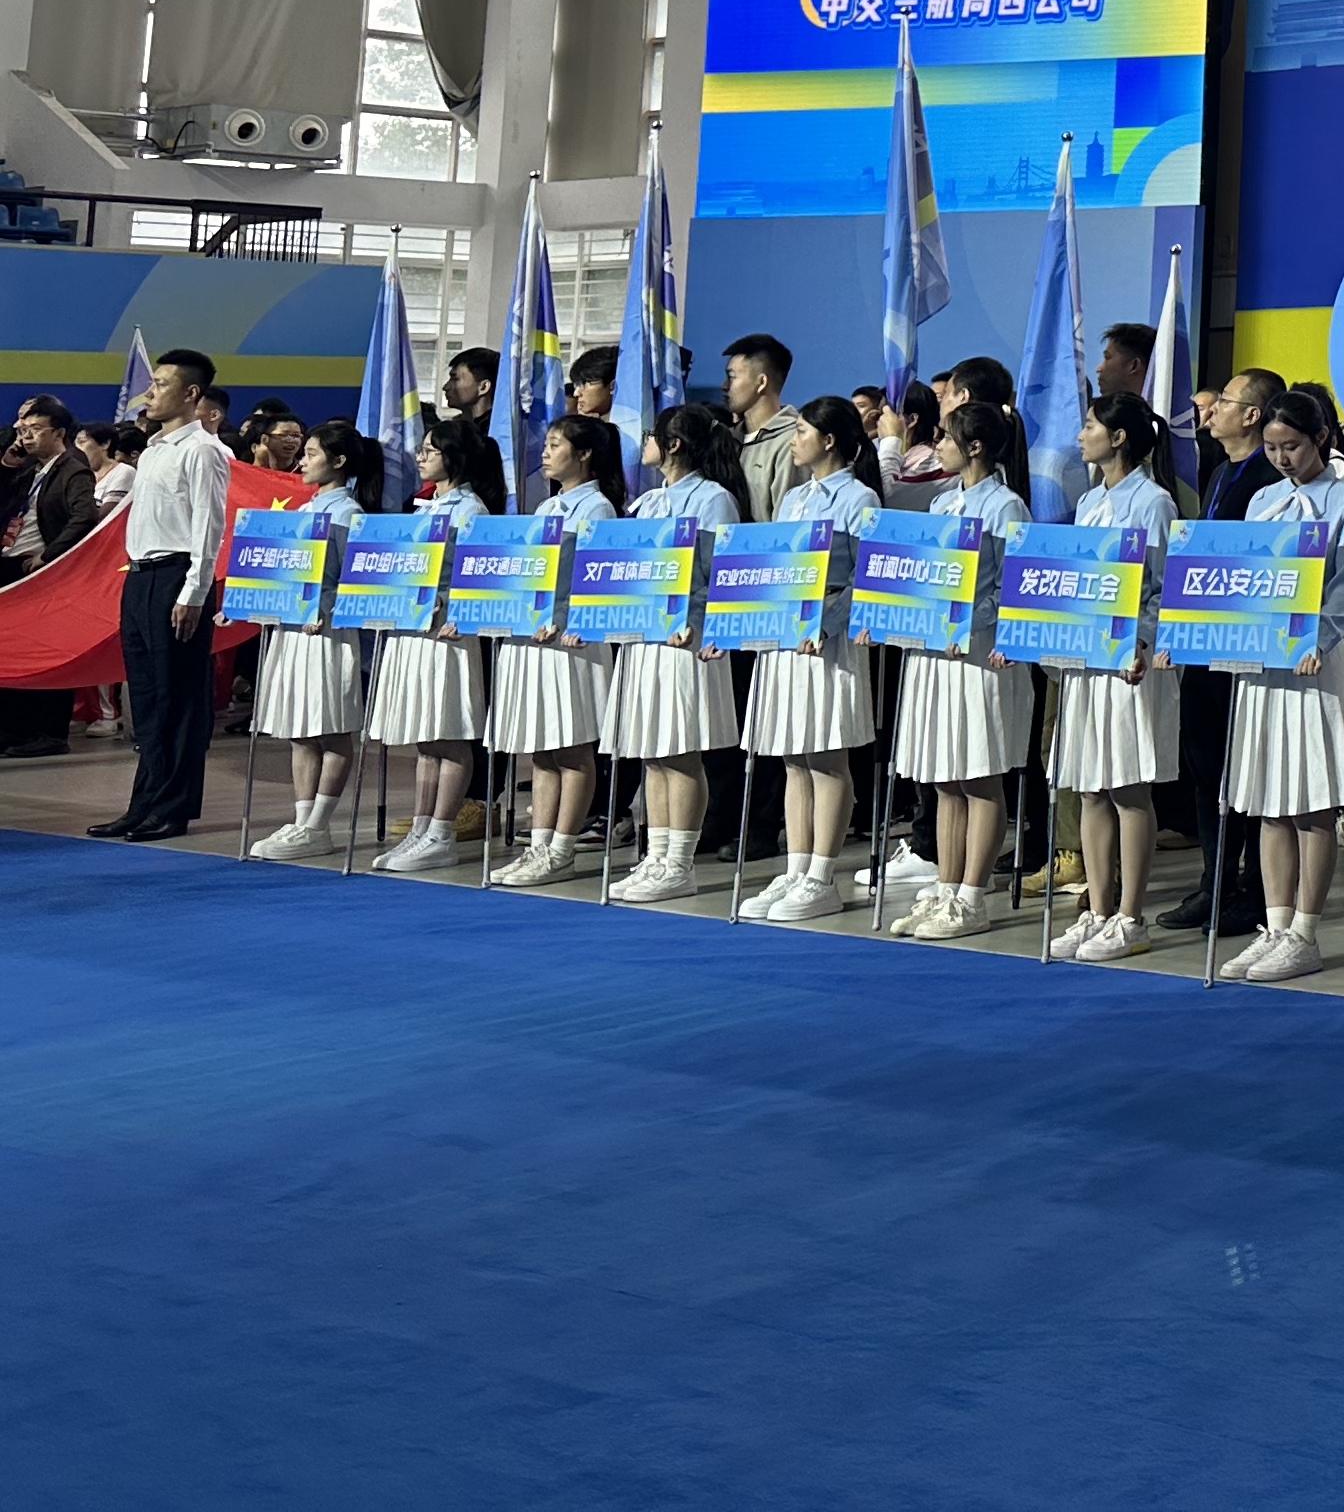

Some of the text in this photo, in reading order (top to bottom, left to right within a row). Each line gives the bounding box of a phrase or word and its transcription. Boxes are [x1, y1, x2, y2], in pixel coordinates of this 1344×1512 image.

[238, 546, 313, 570] 小学组代表队
[351, 552, 430, 575] 高中组代表队
[460, 556, 548, 577] 建设交通局工会
[583, 559, 680, 582] 文广旅体局工会
[866, 553, 964, 588] 新闻中心工会
[1019, 568, 1121, 602] 发改局工会
[1182, 567, 1300, 598] 区公安分局
[223, 587, 291, 612] ZHENHAI
[334, 594, 404, 617] ZHENHAI
[448, 599, 521, 624] ZHENHAI
[567, 605, 653, 629] ZHENHAI
[704, 612, 785, 637] ZHENHAI
[850, 602, 935, 635] ZHENHAI
[996, 620, 1094, 652] ZHENHAI
[1156, 622, 1269, 652] ZHENHAI
